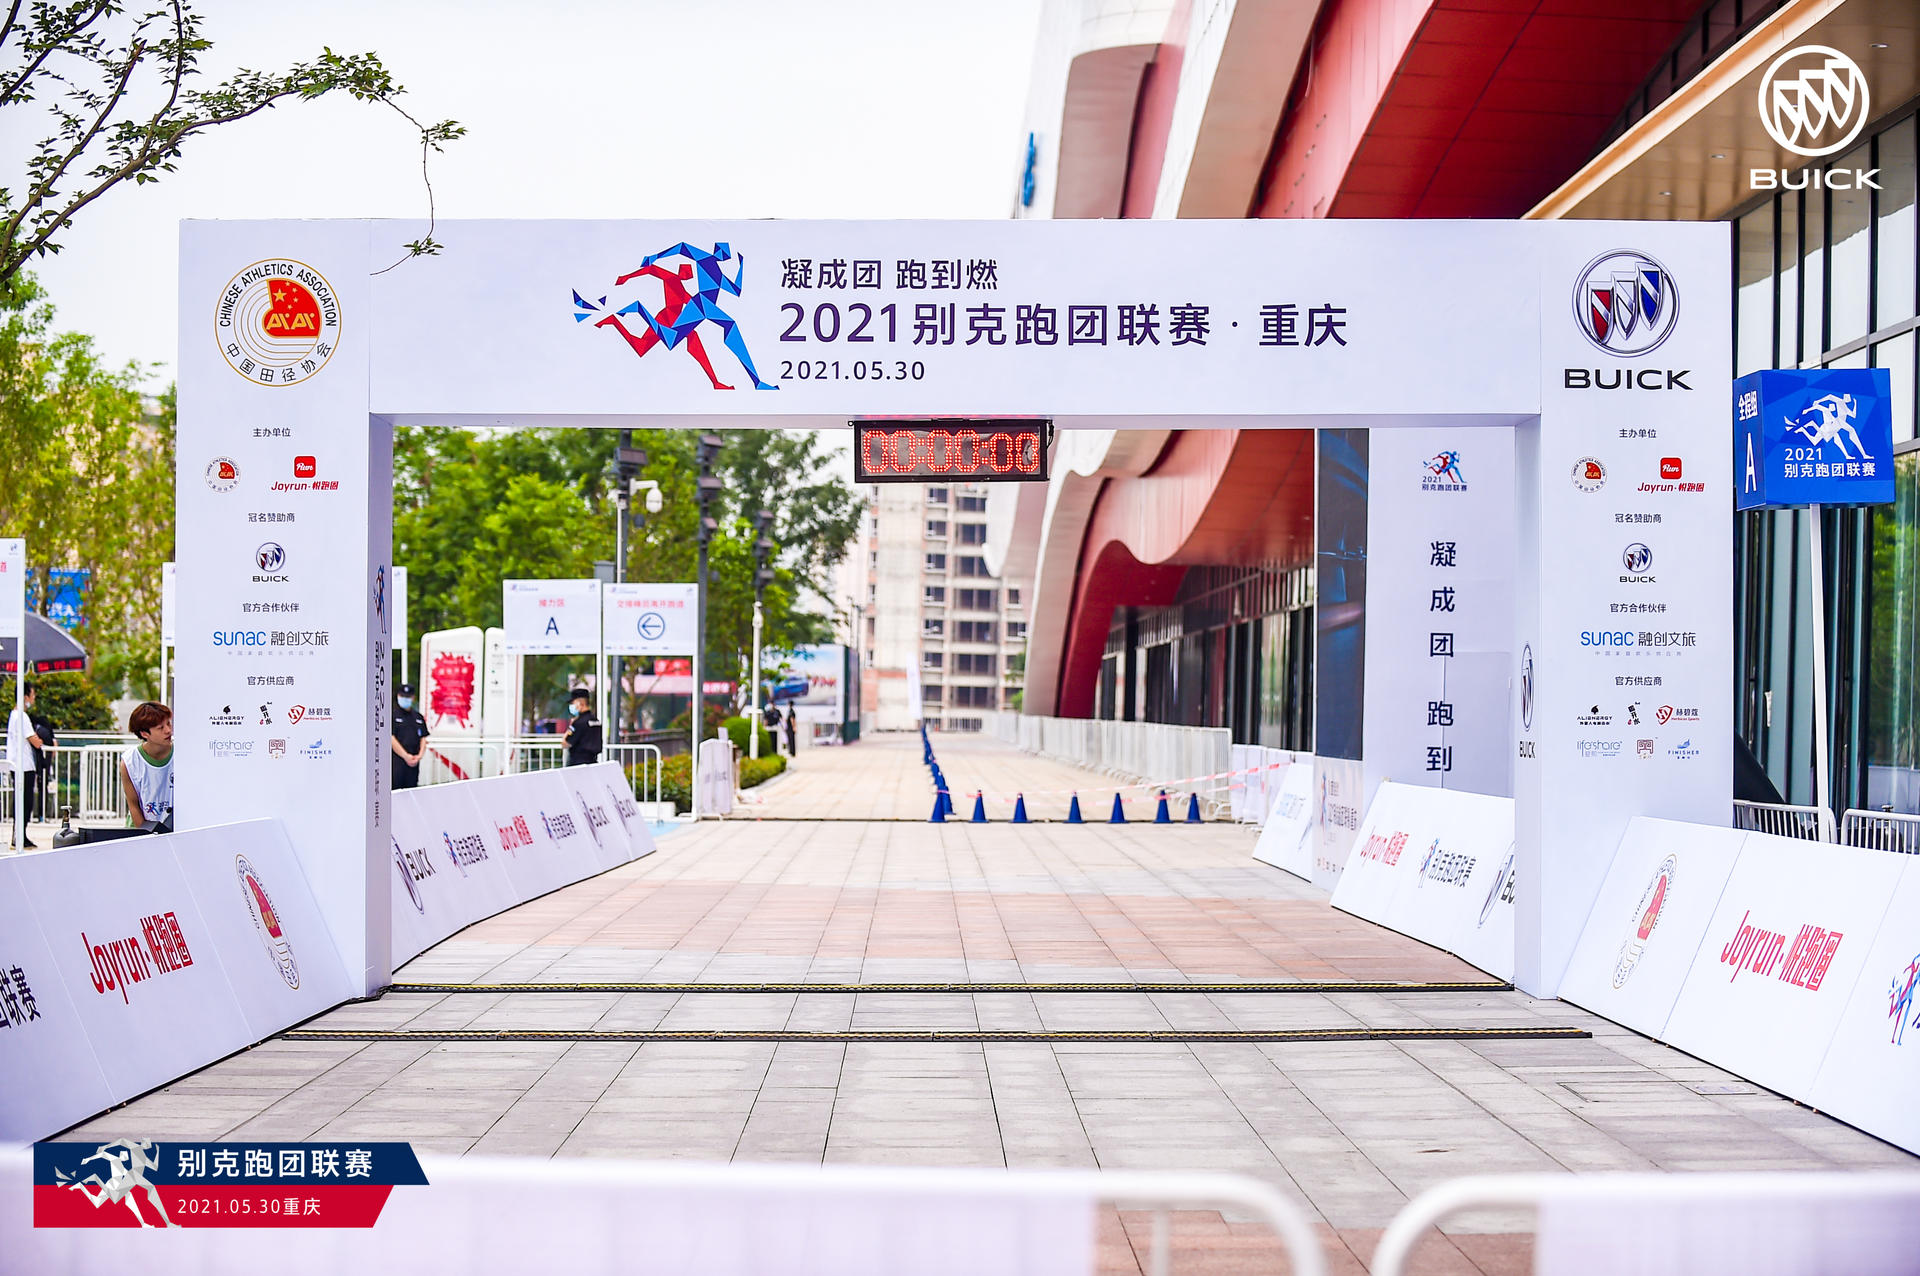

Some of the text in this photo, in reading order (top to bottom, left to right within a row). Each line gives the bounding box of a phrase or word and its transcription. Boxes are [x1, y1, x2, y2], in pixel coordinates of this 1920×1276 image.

[780, 258, 998, 291] 凝成团 跑到燃
[220, 263, 337, 328] CHINESE ATHLETICS ASSOCIATION
[226, 341, 332, 383] 中国田径协会
[779, 360, 926, 381] 2021.05.30
[1564, 368, 1694, 391] BUICK
[252, 427, 291, 438] 主办单位
[1619, 428, 1657, 439] 主办单位
[861, 428, 1040, 474] 00:00:00
[1784, 448, 1823, 461] 2021
[1745, 432, 1757, 494] A
[1784, 462, 1876, 478] 别克跑团联赛
[1422, 475, 1442, 483] 2021
[248, 512, 295, 523] 冠名赞助商
[1614, 513, 1662, 524] 冠名赞助商
[252, 575, 290, 583] BUICK
[242, 602, 300, 613] 官方合作伙伴
[1610, 603, 1667, 613] 官方合作伙伴
[545, 617, 560, 636] A
[270, 631, 329, 646] 融创文旅
[1638, 631, 1696, 647] 融创文旅
[247, 675, 295, 686] 官方供应商
[1614, 676, 1662, 686] 官方供应商
[1519, 740, 1536, 759] BUICK
[405, 847, 437, 881] BUICK
